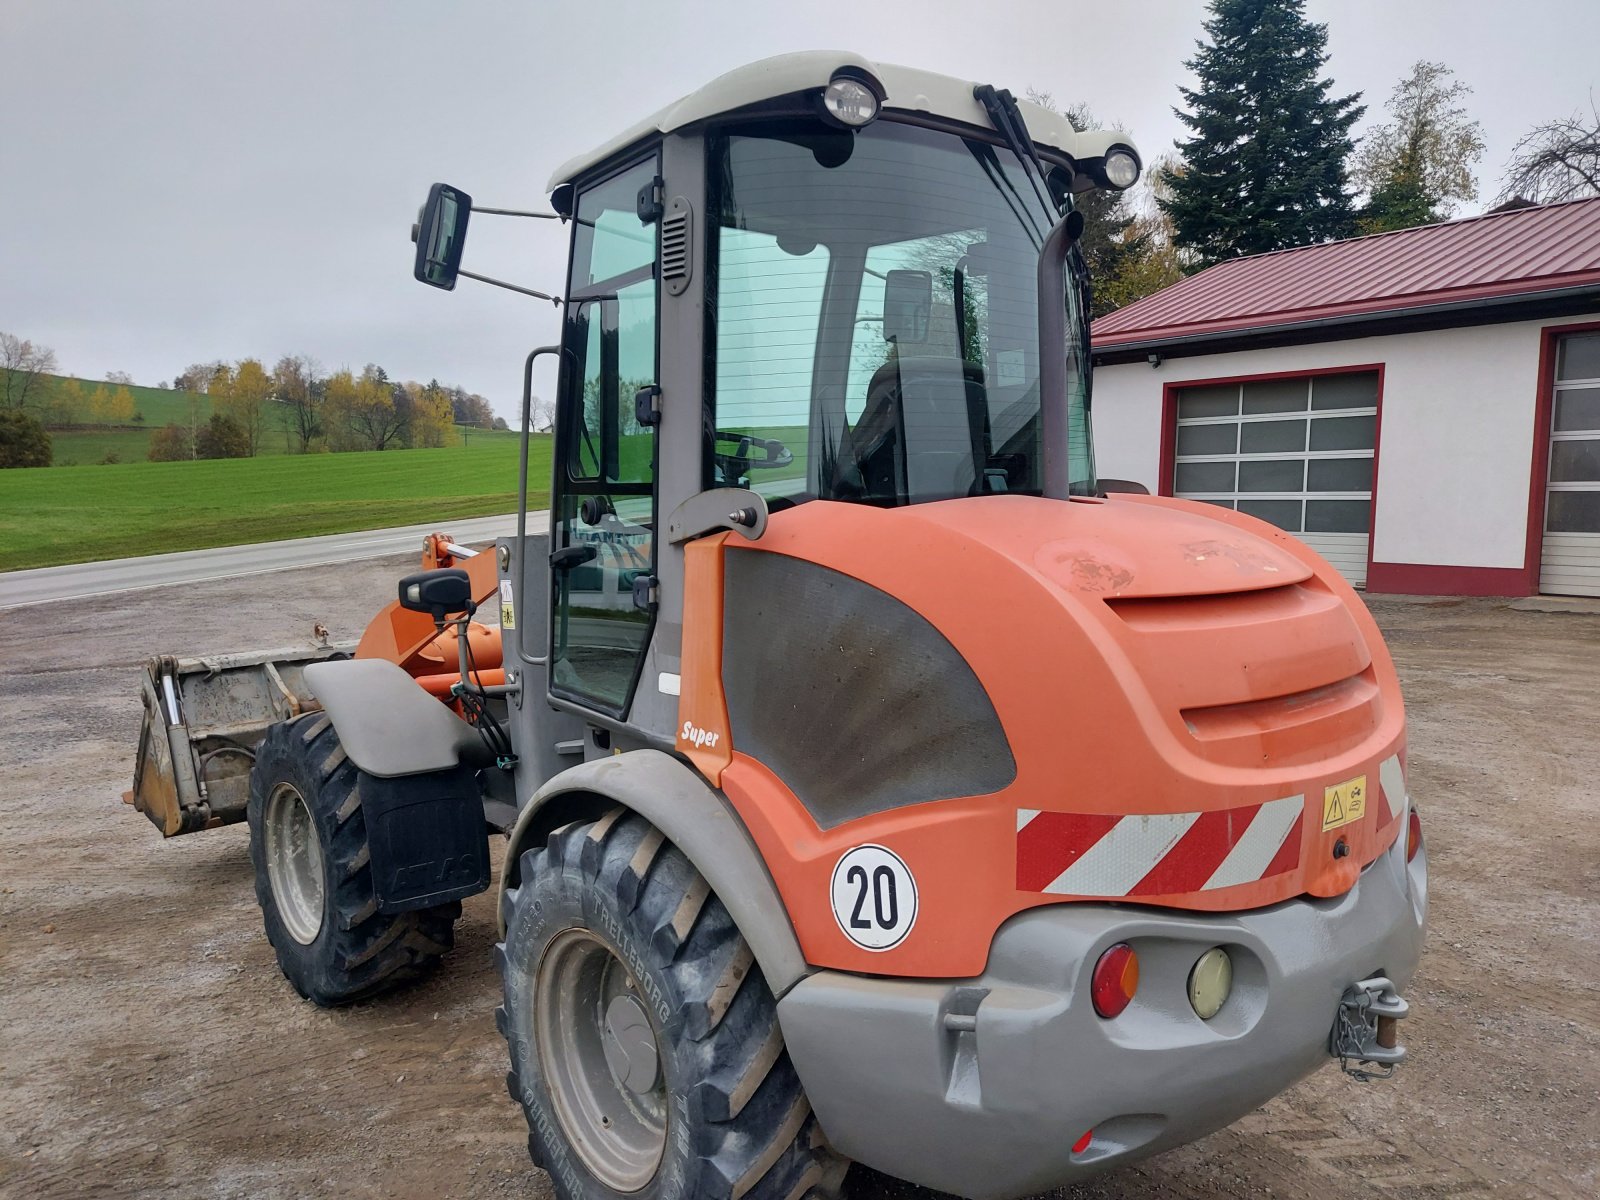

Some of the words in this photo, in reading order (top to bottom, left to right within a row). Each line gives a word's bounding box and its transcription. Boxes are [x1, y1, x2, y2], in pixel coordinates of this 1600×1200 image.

[681, 721, 719, 748] Super
[847, 865, 898, 930] 20
[593, 890, 671, 1024] TRELLEBORG
